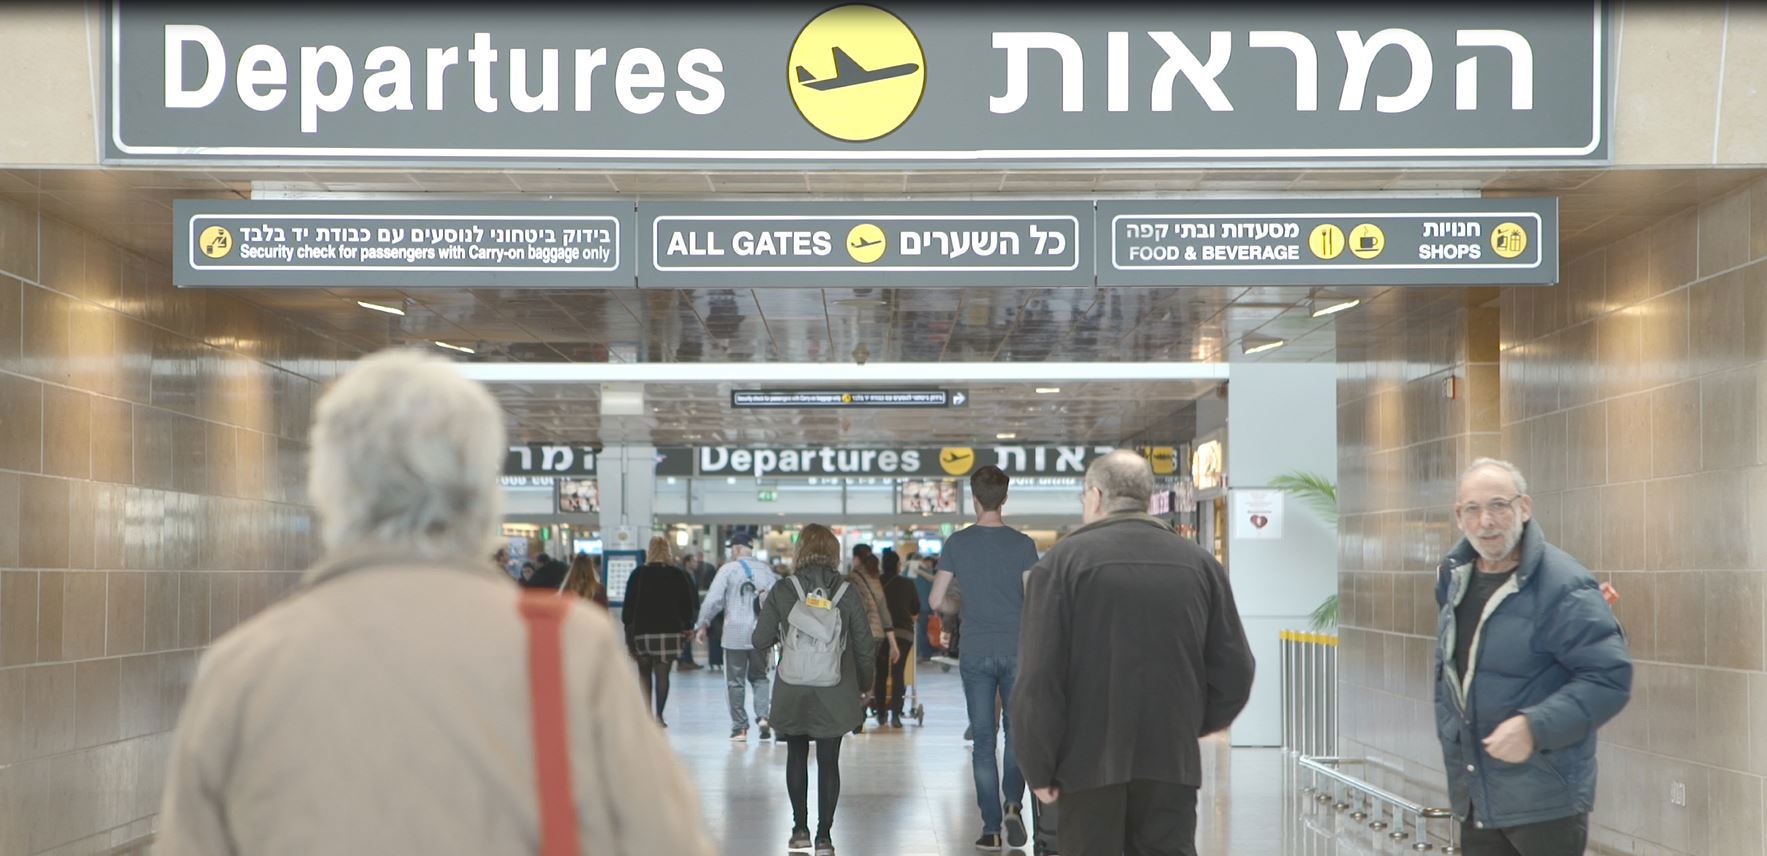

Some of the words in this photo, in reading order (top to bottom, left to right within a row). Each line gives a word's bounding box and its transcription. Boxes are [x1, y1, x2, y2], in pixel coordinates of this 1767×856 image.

[165, 24, 725, 133] Departures
[990, 28, 1533, 113] המראות
[239, 224, 286, 242] בלבד
[291, 227, 309, 242] יד
[315, 227, 371, 242] כבודת
[377, 228, 405, 244] עם
[411, 225, 484, 244] לנוסעים
[490, 228, 557, 243] ביטחוני
[563, 228, 611, 246] בידוק
[1126, 224, 1169, 242] קפה
[1174, 223, 1216, 238] ובתי
[1221, 223, 1300, 240] מסעדות
[1422, 221, 1481, 238] חנויות
[666, 231, 725, 256] ALL
[732, 231, 832, 256] GATES
[900, 231, 1020, 258] השערים
[1029, 225, 1066, 255] כל
[240, 244, 294, 262] Security
[297, 244, 336, 259] check
[339, 244, 358, 259] for
[360, 247, 436, 262] passengers
[438, 245, 466, 260] with
[468, 245, 525, 262] Carry-on
[528, 245, 580, 263] baggage
[582, 246, 611, 262] only
[1129, 246, 1180, 261] FOOD
[1184, 246, 1198, 261] &
[1202, 245, 1300, 261] BEVERAGE
[1418, 243, 1482, 260] SHOPS
[701, 446, 921, 477] Departures
